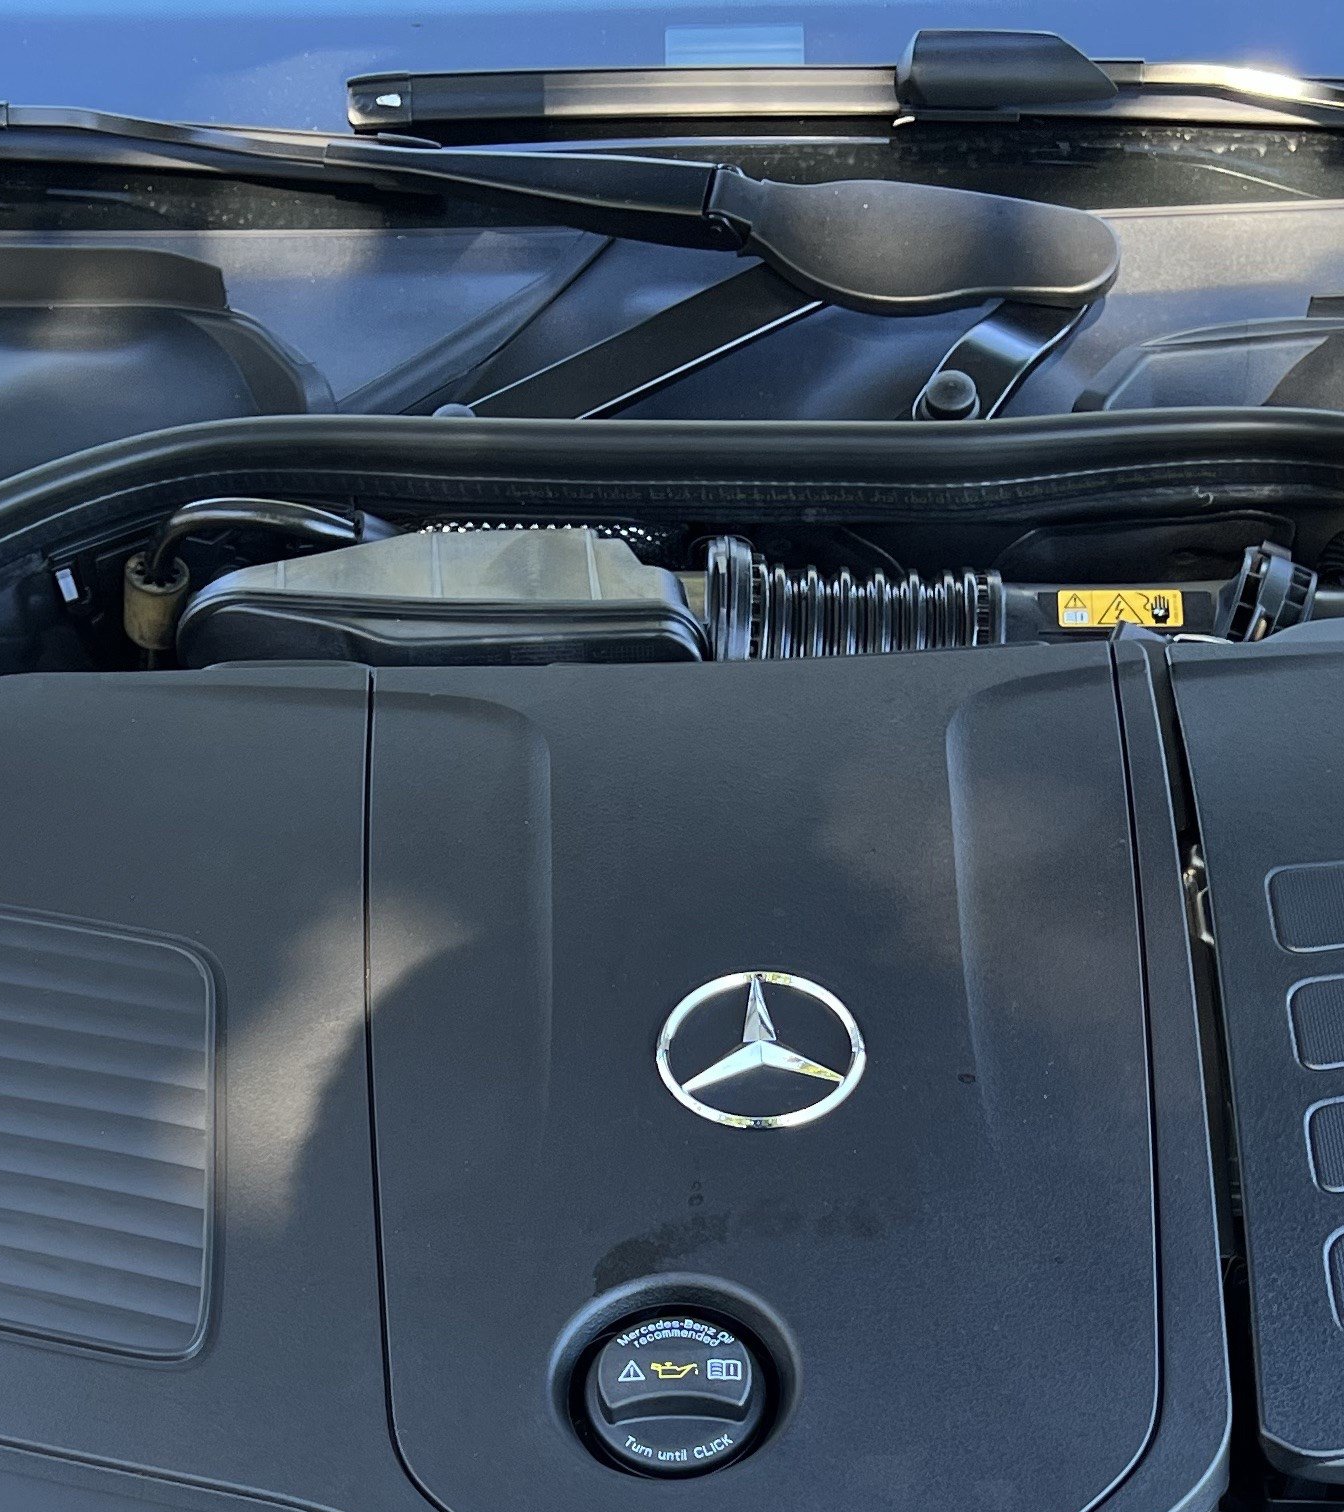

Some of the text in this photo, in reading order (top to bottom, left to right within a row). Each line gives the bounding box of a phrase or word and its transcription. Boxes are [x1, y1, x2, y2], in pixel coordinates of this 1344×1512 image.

[617, 1319, 735, 1347] Mercedes-Benz Oil
[634, 1328, 719, 1348] recommended
[624, 1433, 733, 1462] Turn until CLICK
